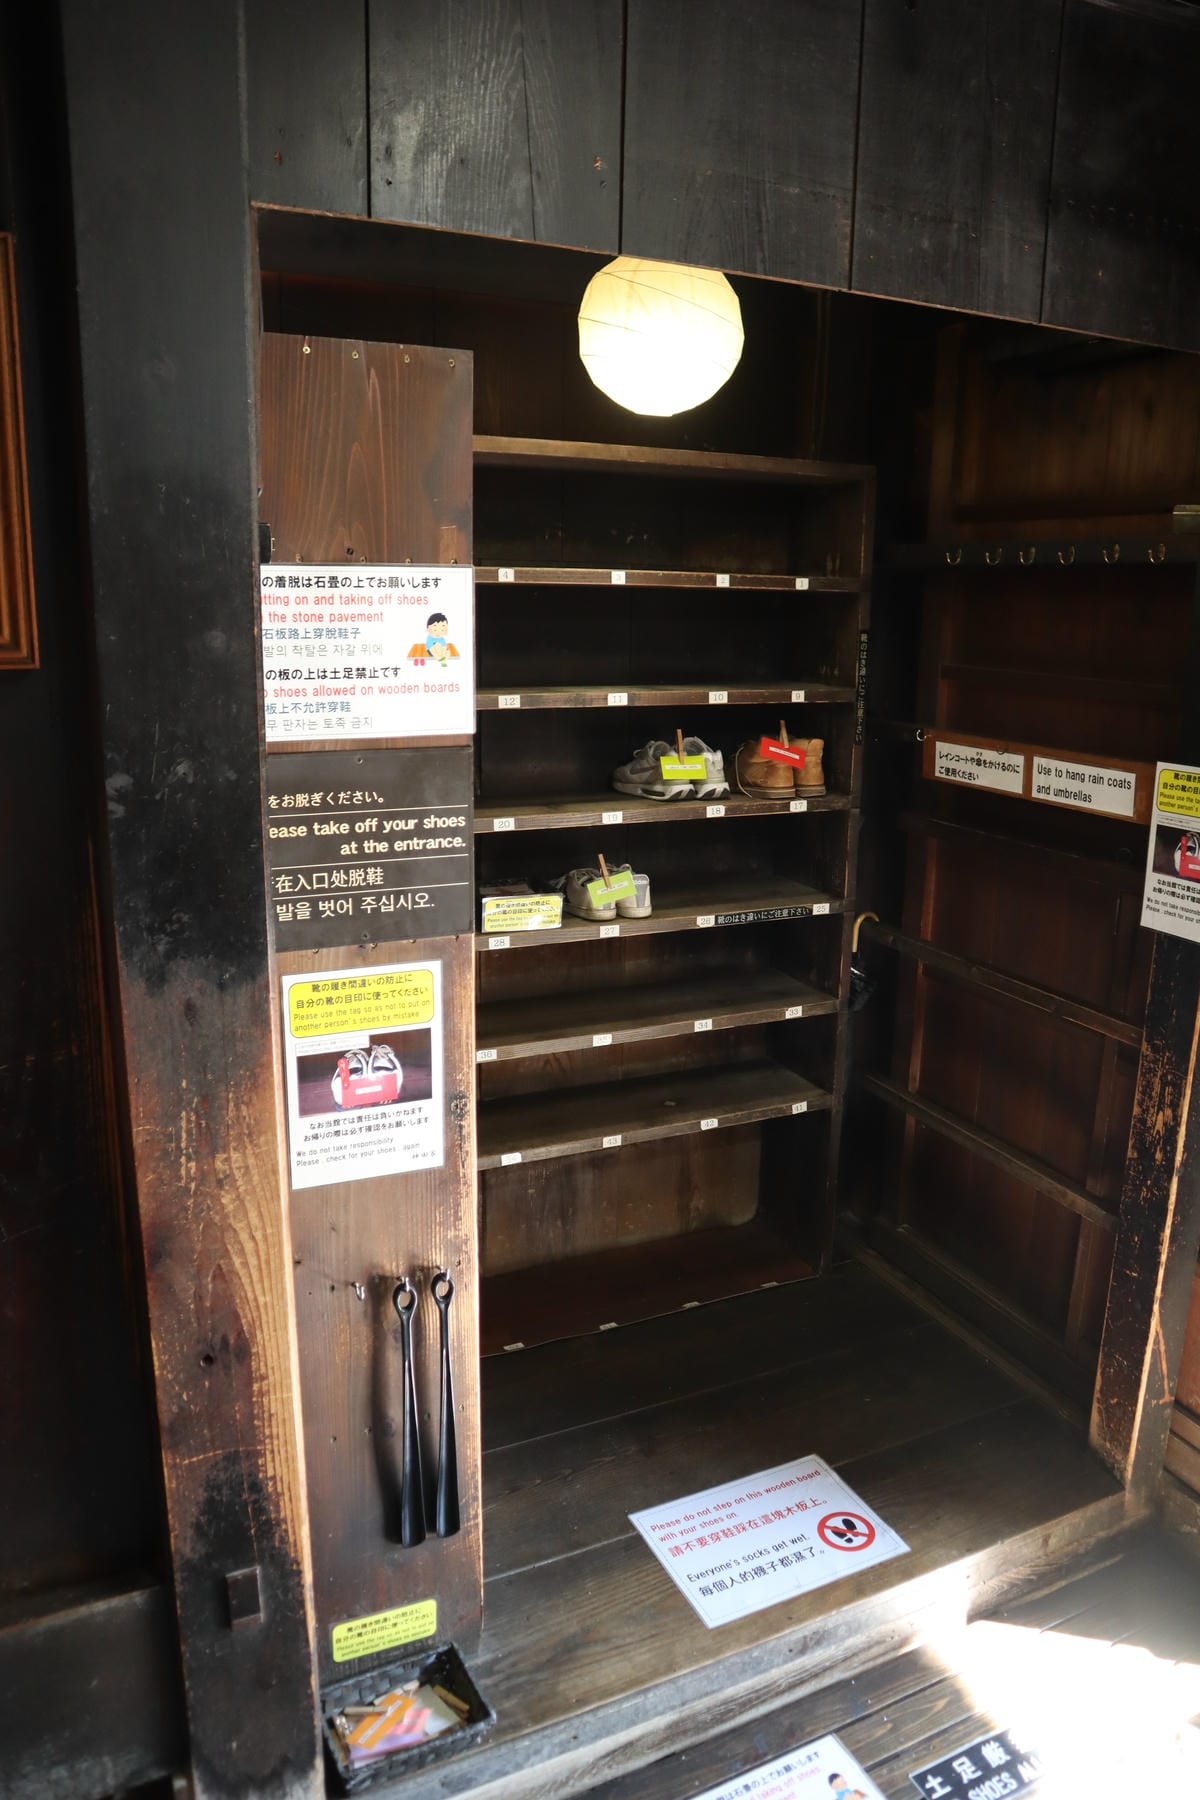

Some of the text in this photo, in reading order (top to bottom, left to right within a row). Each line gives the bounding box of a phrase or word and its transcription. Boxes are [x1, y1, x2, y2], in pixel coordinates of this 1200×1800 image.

[261, 575, 442, 589] の着脱は石畳の上でお願いします
[295, 595, 308, 605] on
[314, 593, 334, 605] and
[340, 593, 373, 607] taking
[378, 593, 392, 605] off
[397, 593, 429, 605] shoes
[269, 611, 287, 622] the
[292, 611, 324, 623] stone
[329, 611, 384, 624] pavement
[265, 666, 401, 681] の板の上は土足禁止です
[273, 685, 308, 698] shoes
[312, 684, 356, 697] allowed
[360, 686, 374, 696] on
[378, 683, 419, 695] wooden
[424, 682, 460, 694] boards
[713, 693, 724, 702] 10
[504, 697, 516, 706] 12
[938, 765, 979, 781] ご使用ください
[1037, 763, 1132, 790] Use to hang rain coats
[268, 790, 385, 809] をお脱ぎください。
[1036, 783, 1092, 803] and umbrellas
[269, 815, 466, 839] ease take off your shoes
[498, 820, 510, 829] 20
[340, 835, 466, 856] at the entrance.
[271, 866, 385, 893] 在入口处脱鞋
[276, 892, 436, 922] 발을 벗어 주십시오.
[494, 938, 505, 947] 28
[294, 1011, 318, 1021] Please
[320, 1010, 333, 1018] use
[336, 1007, 347, 1016] the
[349, 1006, 361, 1016] tag
[385, 1002, 396, 1011] not
[398, 1001, 406, 1009] to
[408, 1000, 419, 1009] put
[421, 999, 430, 1007] on
[294, 1022, 322, 1032] another
[359, 1015, 380, 1024] shoes
[382, 1014, 391, 1022] by
[393, 1010, 419, 1020] mistake
[309, 1148, 318, 1156] do
[319, 1146, 330, 1154] not
[333, 1144, 348, 1153] take
[650, 1469, 821, 1533] Please do not step on this wooden board
[658, 1512, 737, 1543] with your shoes on
[686, 1558, 740, 1583] Everyone's
[742, 1548, 771, 1564] socks
[772, 1540, 788, 1554] get
